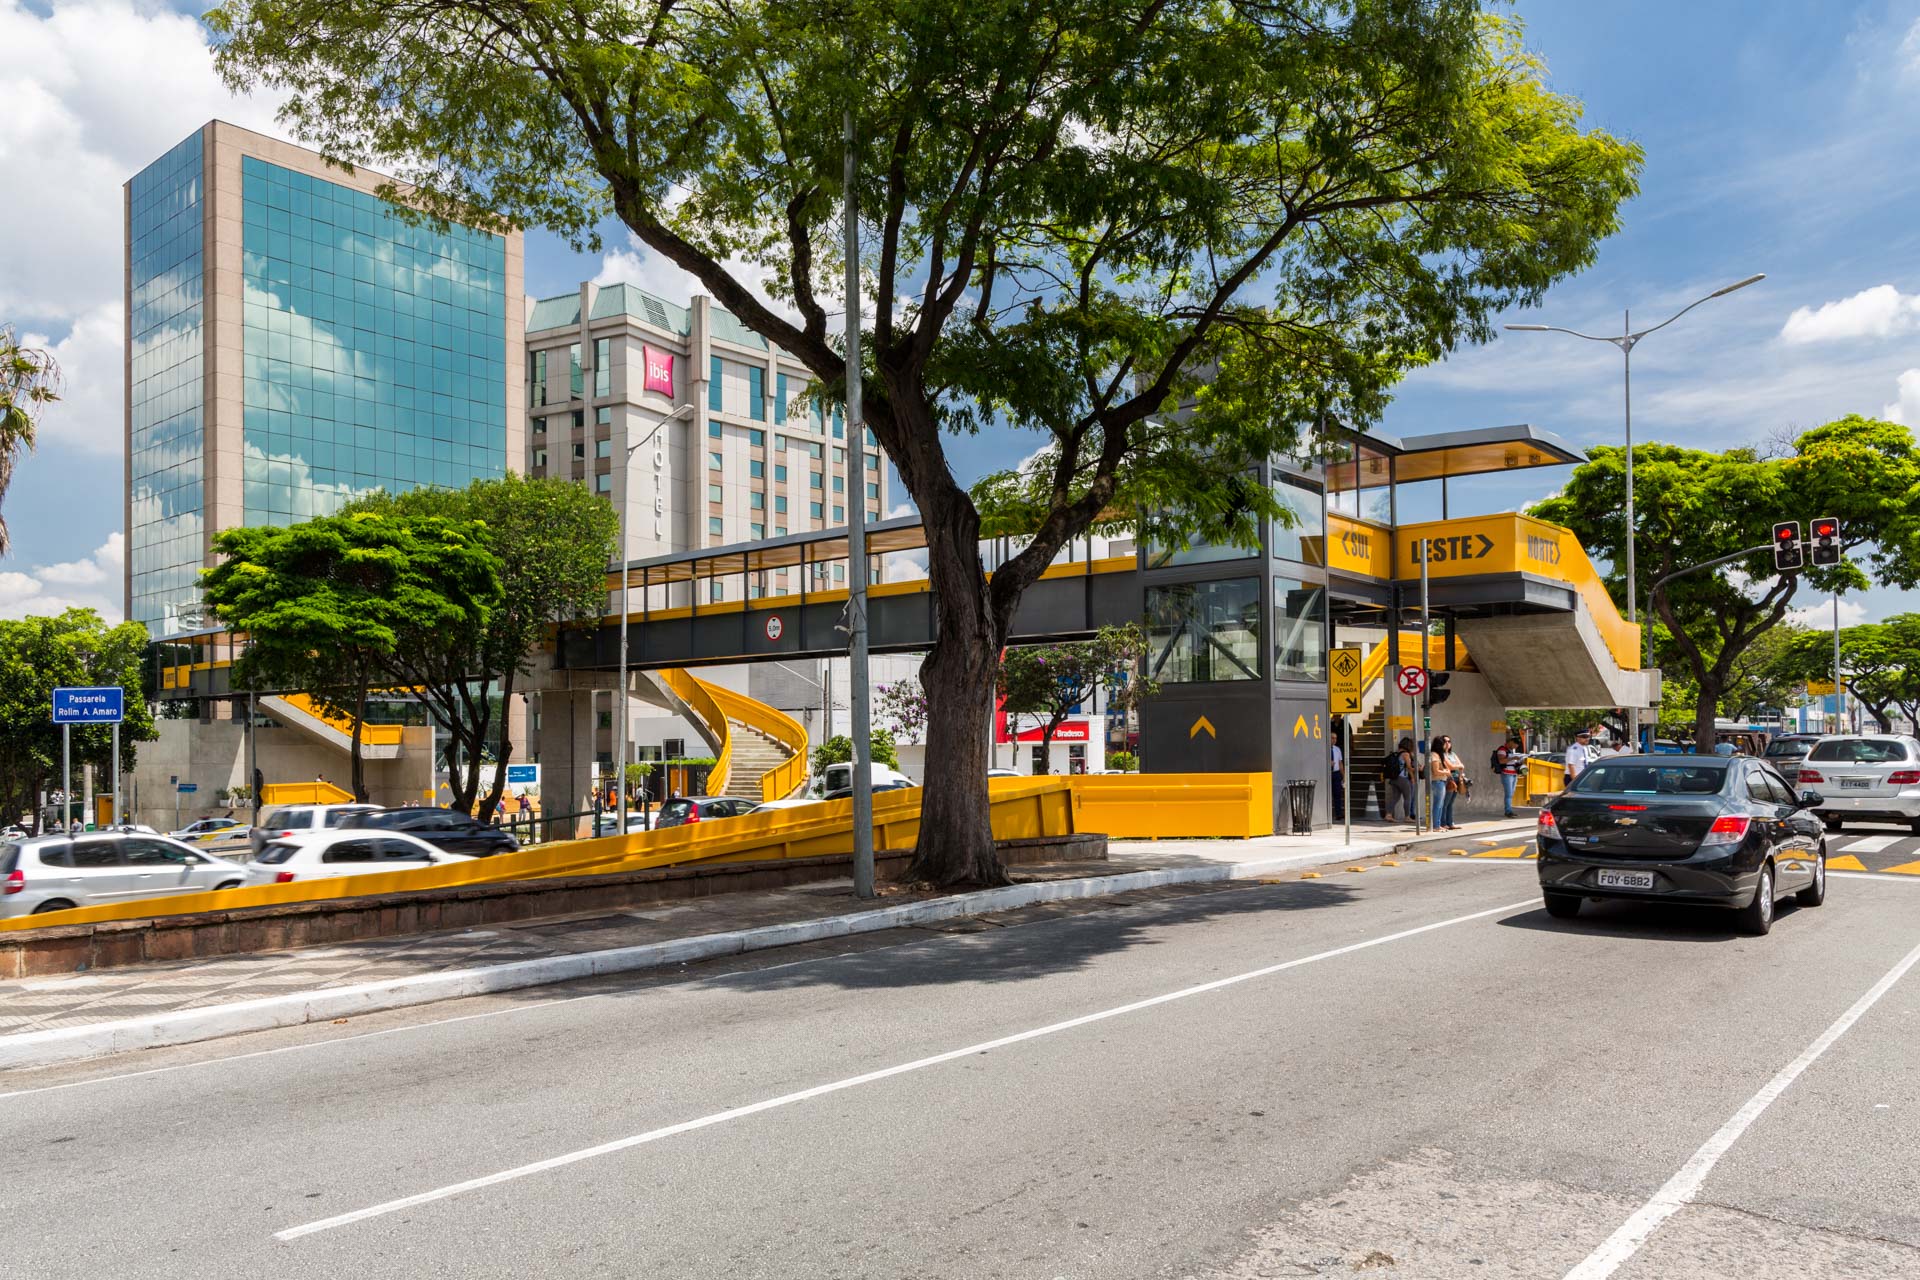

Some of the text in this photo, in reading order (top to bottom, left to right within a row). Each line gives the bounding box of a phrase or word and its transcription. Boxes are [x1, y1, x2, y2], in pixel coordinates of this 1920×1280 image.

[649, 361, 670, 383] ibis
[654, 428, 663, 536] HOTEL
[1351, 532, 1370, 560] SUL
[1527, 534, 1554, 564] NORTE
[69, 694, 106, 703] Passarela
[58, 708, 80, 716] Rolim
[92, 707, 118, 716] Amaro
[1057, 729, 1085, 738] Bradesco
